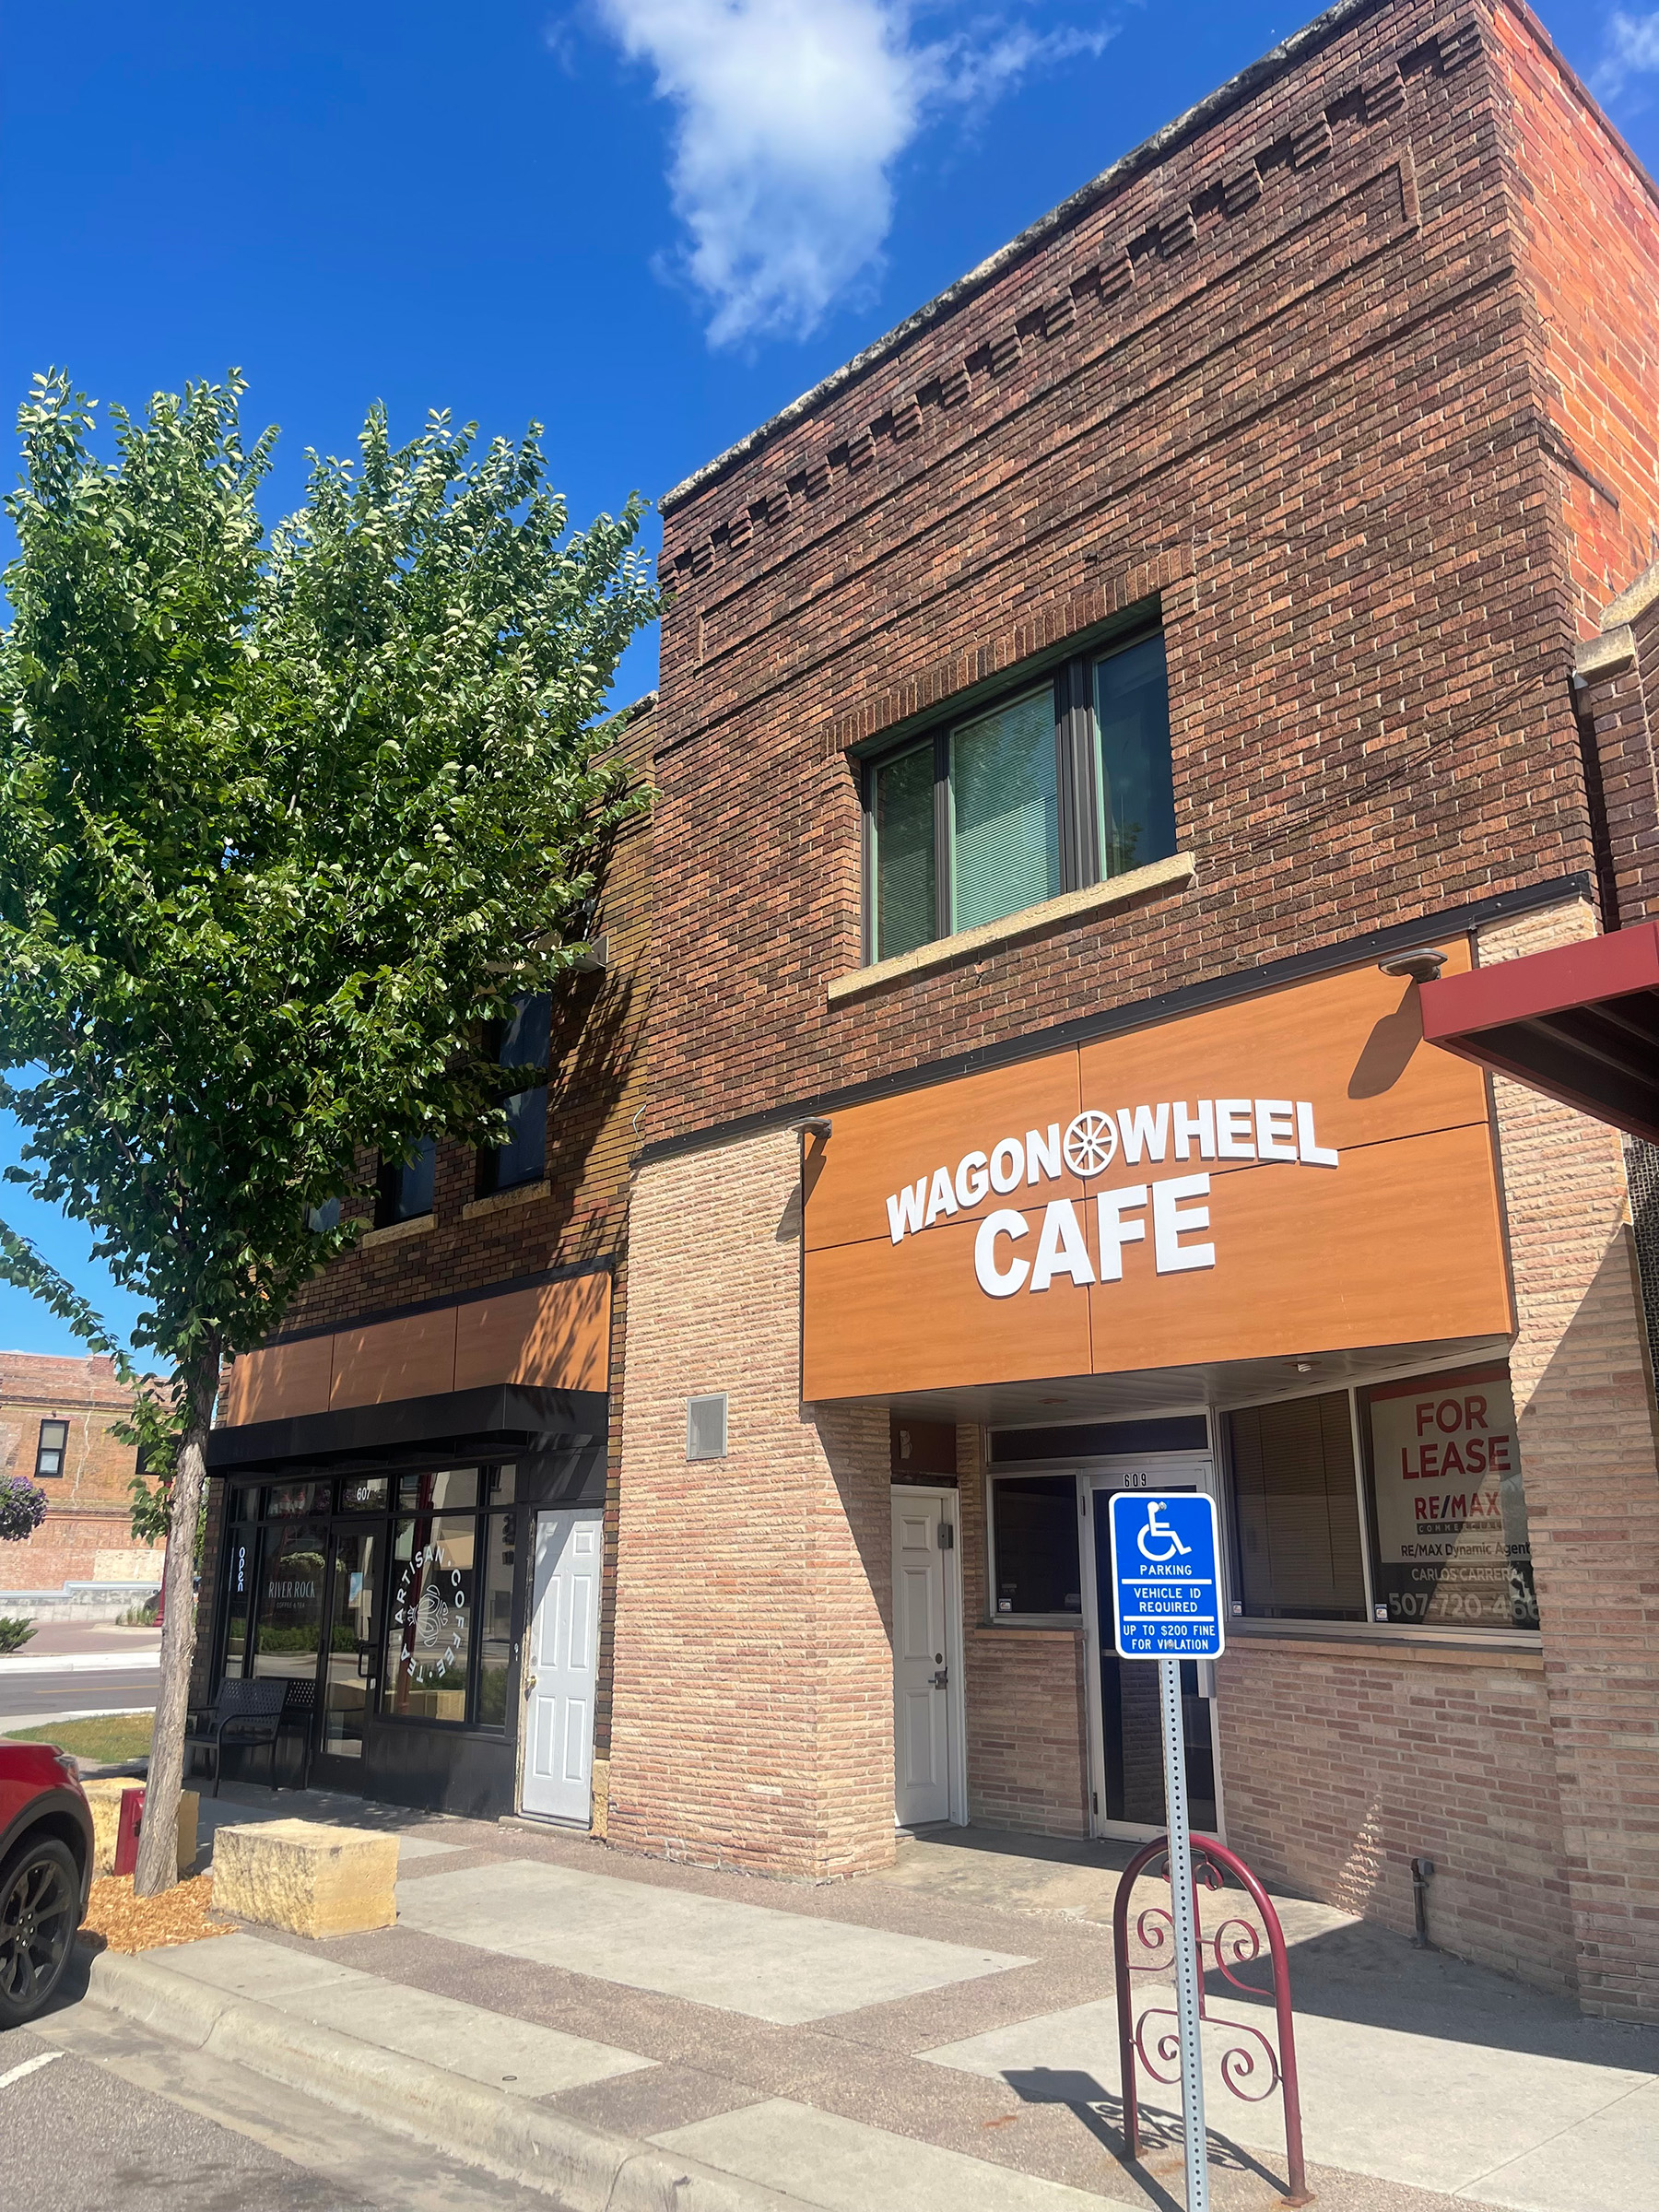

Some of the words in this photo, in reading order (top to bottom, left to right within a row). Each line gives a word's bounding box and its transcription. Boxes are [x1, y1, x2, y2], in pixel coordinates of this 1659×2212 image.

[886, 1123, 1062, 1244] WAGON
[1116, 1099, 1339, 1169] WHEEL
[973, 1171, 1216, 1300] CAFE
[1416, 1394, 1488, 1437] FOR
[1401, 1434, 1512, 1480] LEASE
[1124, 1473, 1147, 1488] 609
[356, 1487, 371, 1501] 607
[1414, 1491, 1501, 1521] RE/MAX
[1418, 1522, 1501, 1533] COMMERCIAL
[1400, 1543, 1443, 1559] RE/MAX
[1445, 1542, 1492, 1558] Dynamic
[1139, 1564, 1193, 1576] PARKING
[1411, 1568, 1456, 1582] CARLOS
[268, 1581, 292, 1599] RIVER
[293, 1580, 315, 1598] ROCK
[394, 1544, 445, 1625] ARTISAN
[1133, 1587, 1182, 1599] VEHICLE
[1189, 1587, 1202, 1598] ID
[1139, 1601, 1198, 1613] REQUIRED
[436, 1568, 465, 1678] COFFEE
[1123, 1625, 1136, 1636] UP
[1142, 1625, 1155, 1636] TO
[1160, 1624, 1188, 1636] $200
[1193, 1624, 1216, 1636] FINE
[1132, 1639, 1152, 1650] FOR
[1157, 1639, 1209, 1650] VILATION
[399, 1642, 425, 1684] TEA
